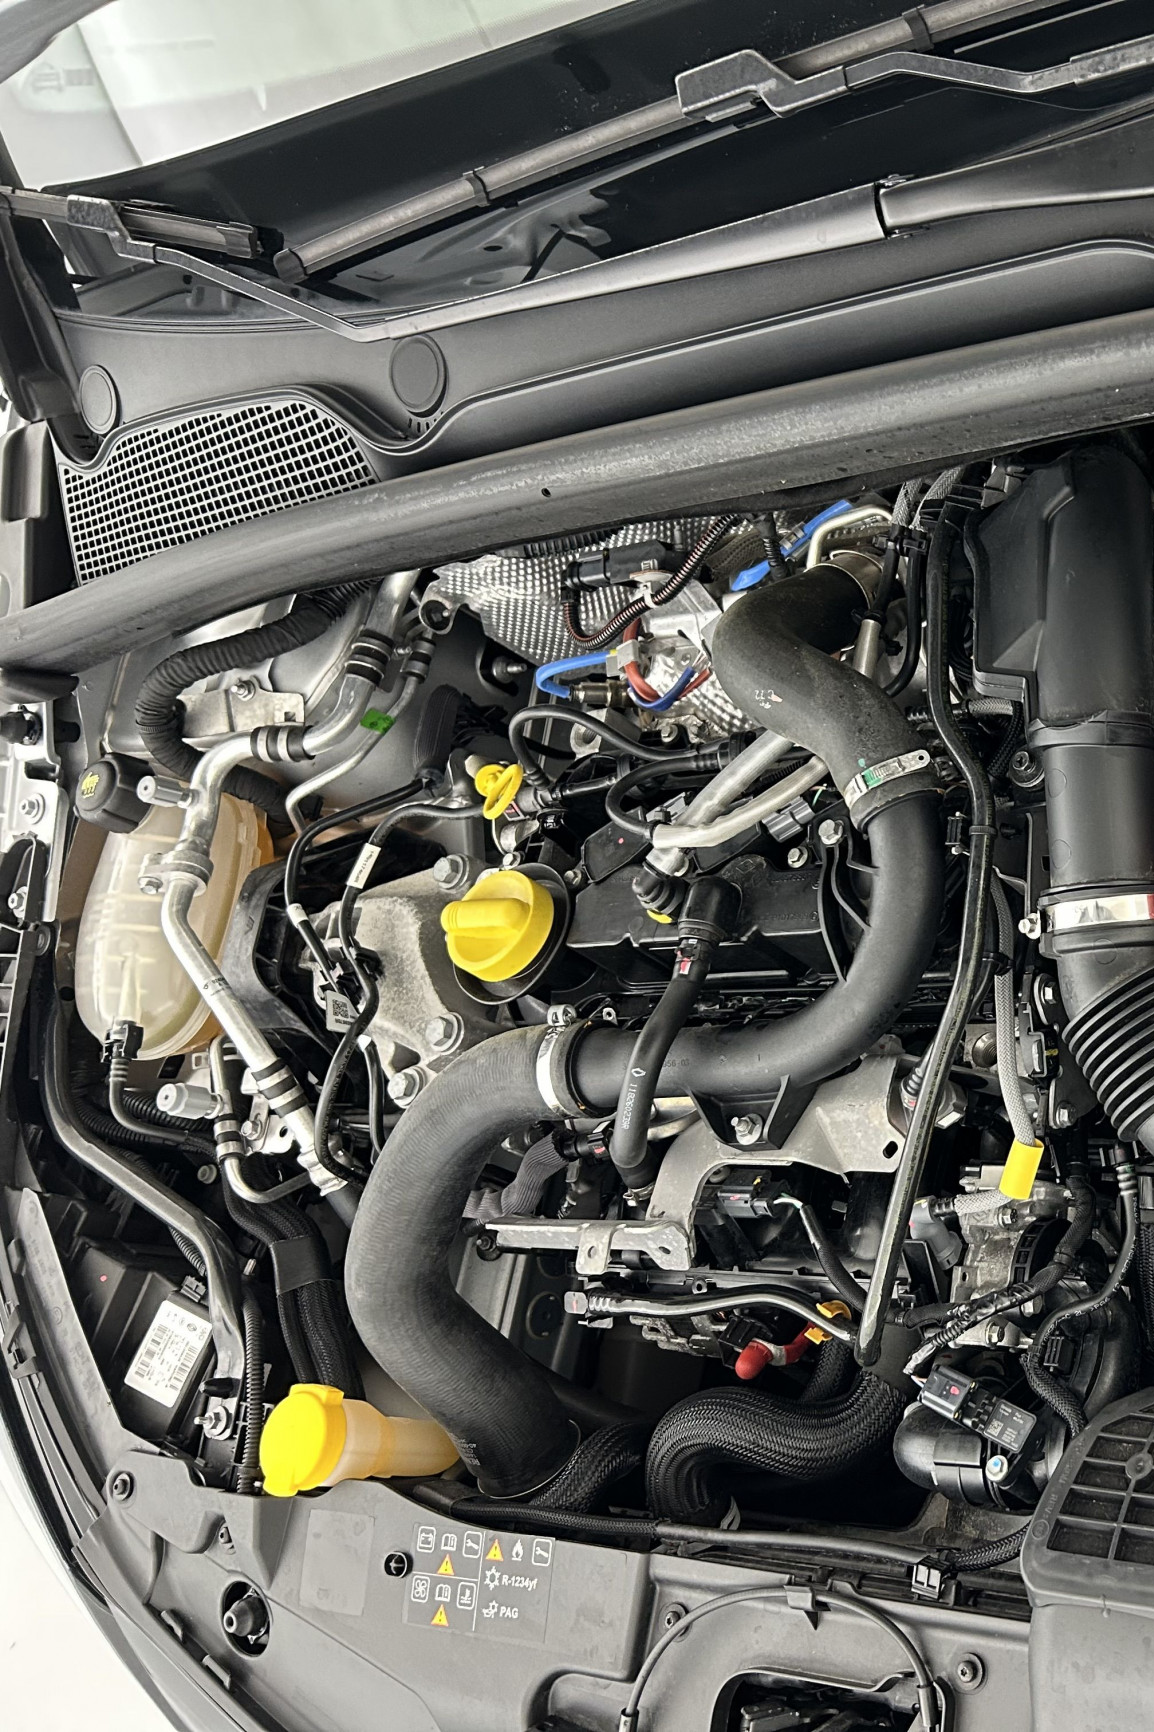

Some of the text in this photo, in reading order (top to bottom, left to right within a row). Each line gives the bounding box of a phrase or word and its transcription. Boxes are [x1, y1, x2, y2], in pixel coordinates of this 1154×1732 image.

[621, 1083, 637, 1129] 118260239R
[502, 1575, 538, 1591] R-1234yf
[500, 1606, 519, 1619] PAG
